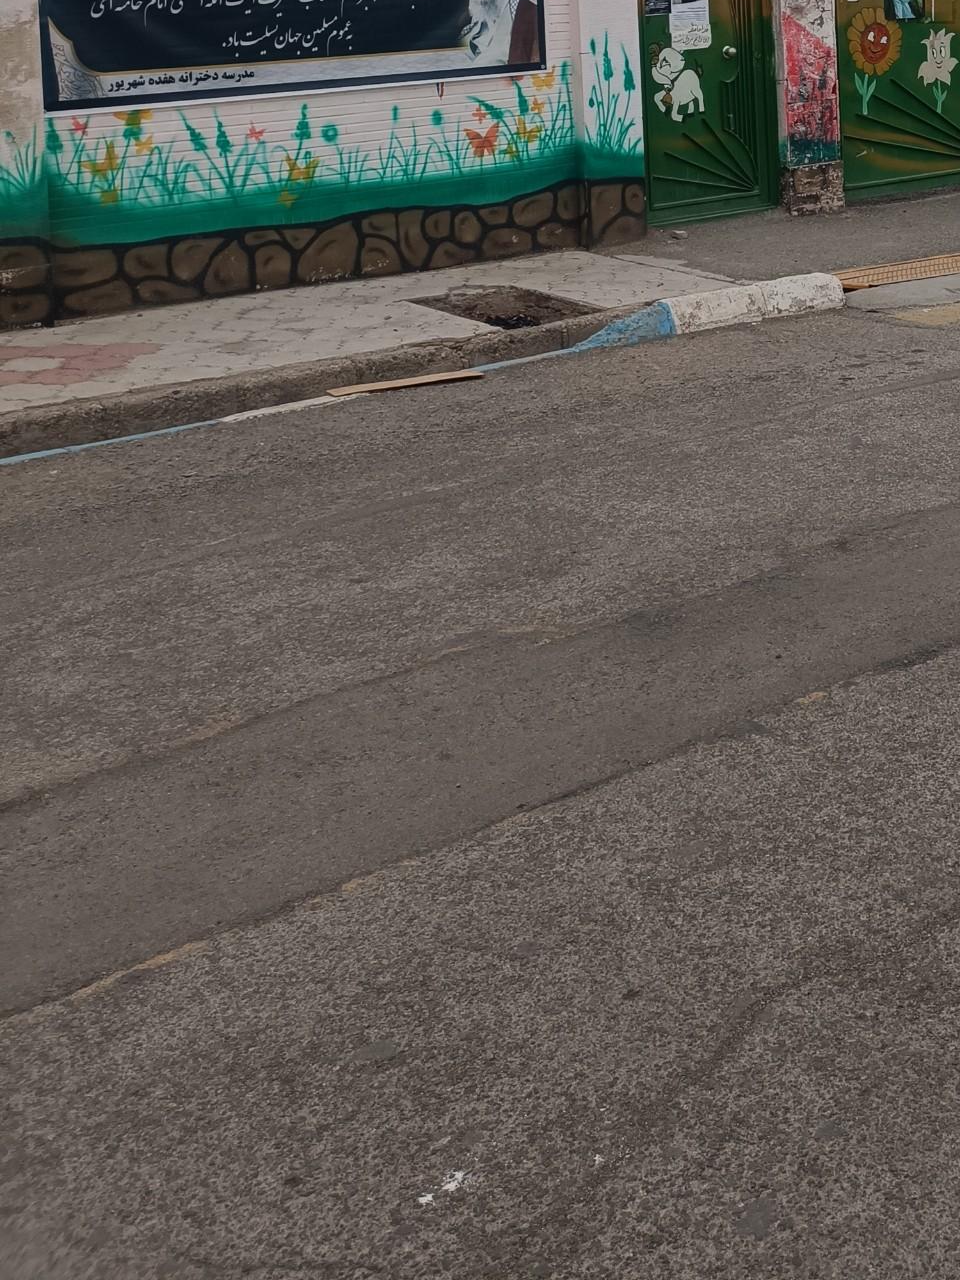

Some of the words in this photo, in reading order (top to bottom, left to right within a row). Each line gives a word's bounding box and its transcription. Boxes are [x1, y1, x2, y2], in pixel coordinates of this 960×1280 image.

[239, 24, 279, 56] تسلیت
[274, 27, 301, 56] جهان
[301, 16, 338, 51] مسلمین
[326, 20, 352, 56] عموم
[108, 74, 146, 93] شهریور
[148, 72, 176, 86] هفده
[178, 70, 219, 87] دخترانه
[221, 70, 255, 83] مدرسه
